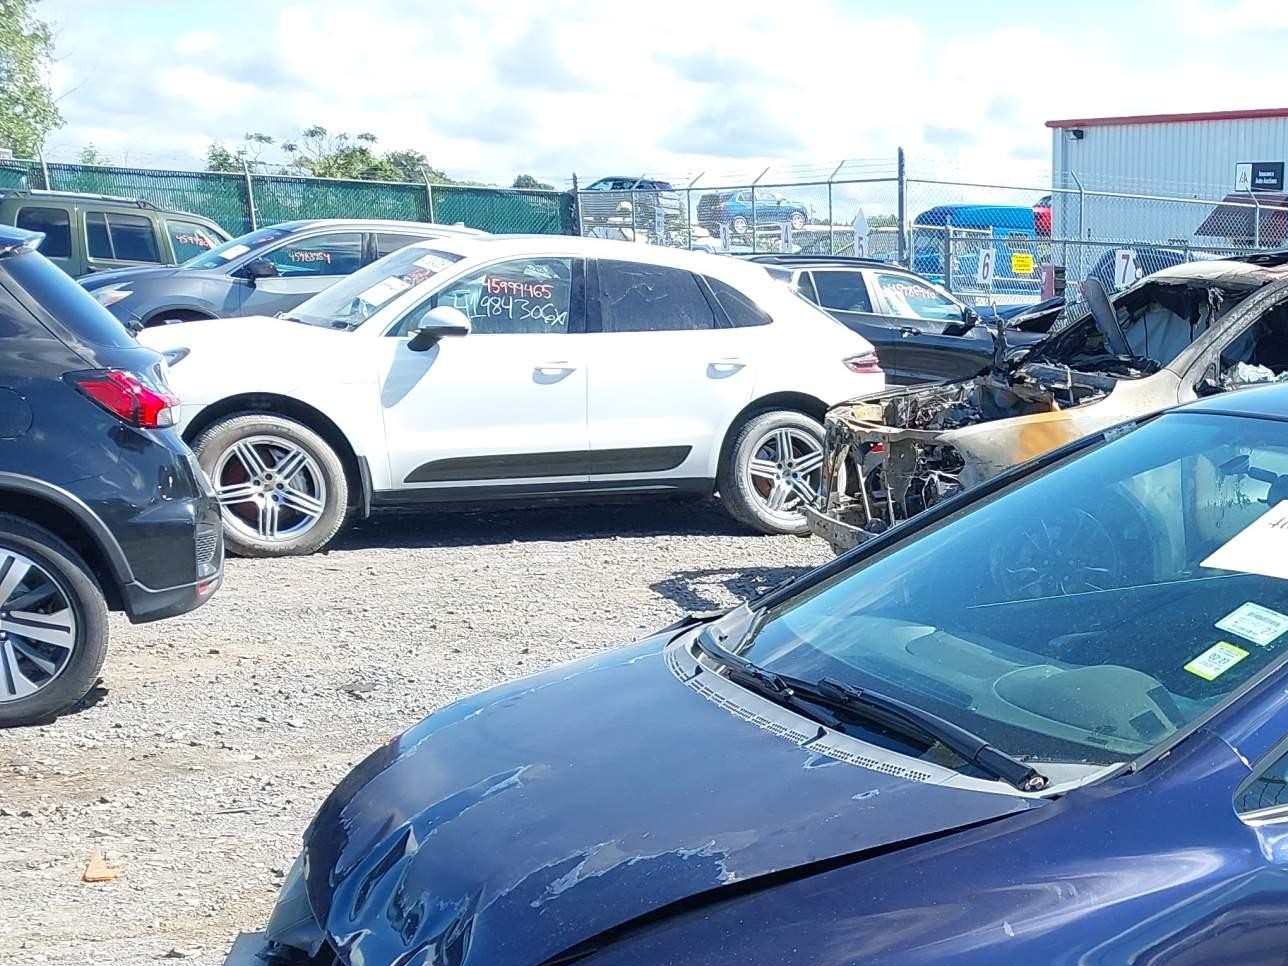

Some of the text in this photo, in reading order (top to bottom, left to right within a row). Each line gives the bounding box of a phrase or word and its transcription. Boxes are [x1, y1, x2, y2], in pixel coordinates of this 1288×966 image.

[857, 236, 864, 257] 5
[982, 253, 991, 280] 6
[1121, 254, 1130, 284] 7
